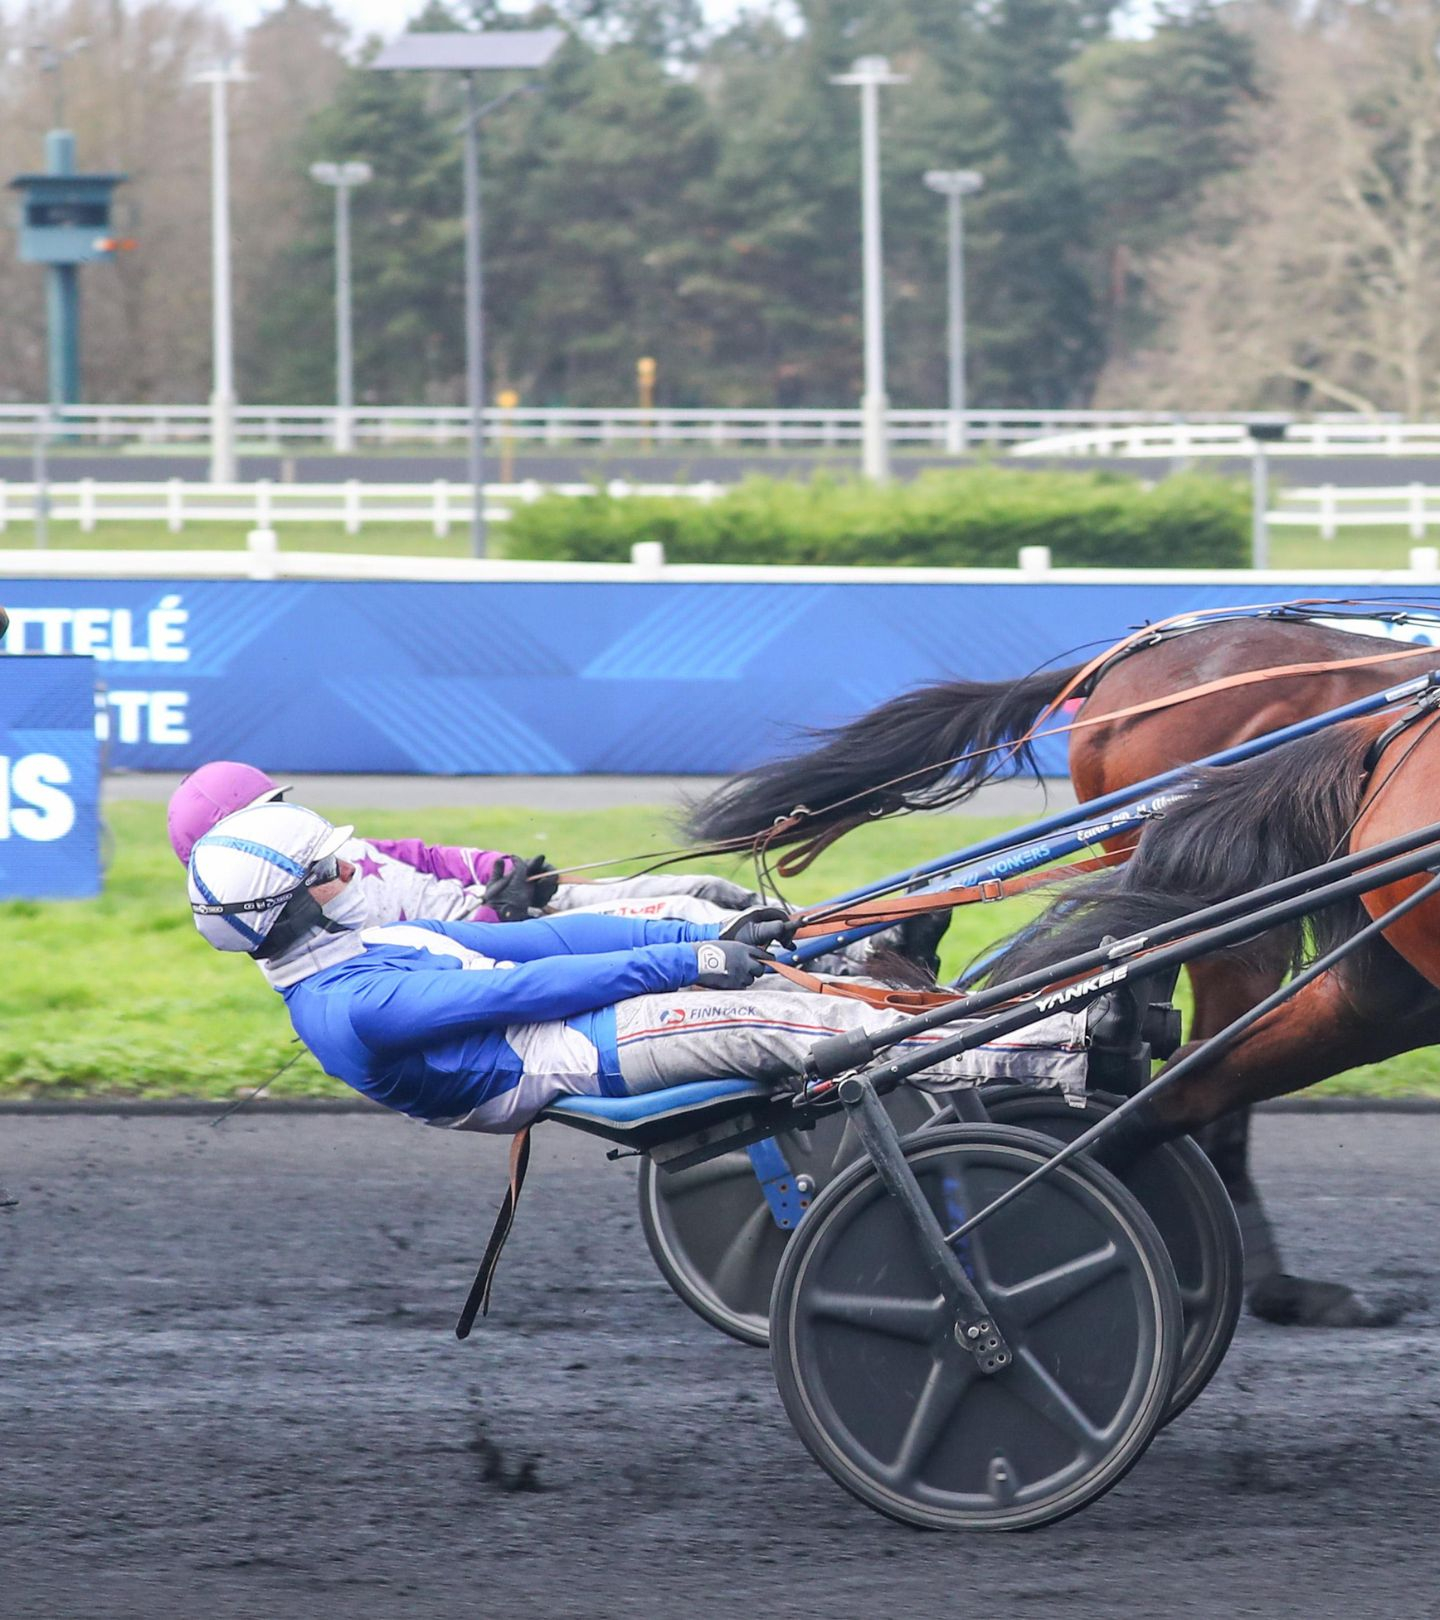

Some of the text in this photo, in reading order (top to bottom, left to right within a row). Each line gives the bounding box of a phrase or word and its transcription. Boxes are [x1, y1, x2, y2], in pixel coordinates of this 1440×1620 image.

[986, 844, 1051, 876] YONKERS
[1034, 965, 1129, 1012] YANKEE
[690, 1006, 756, 1019] FINNTACK
